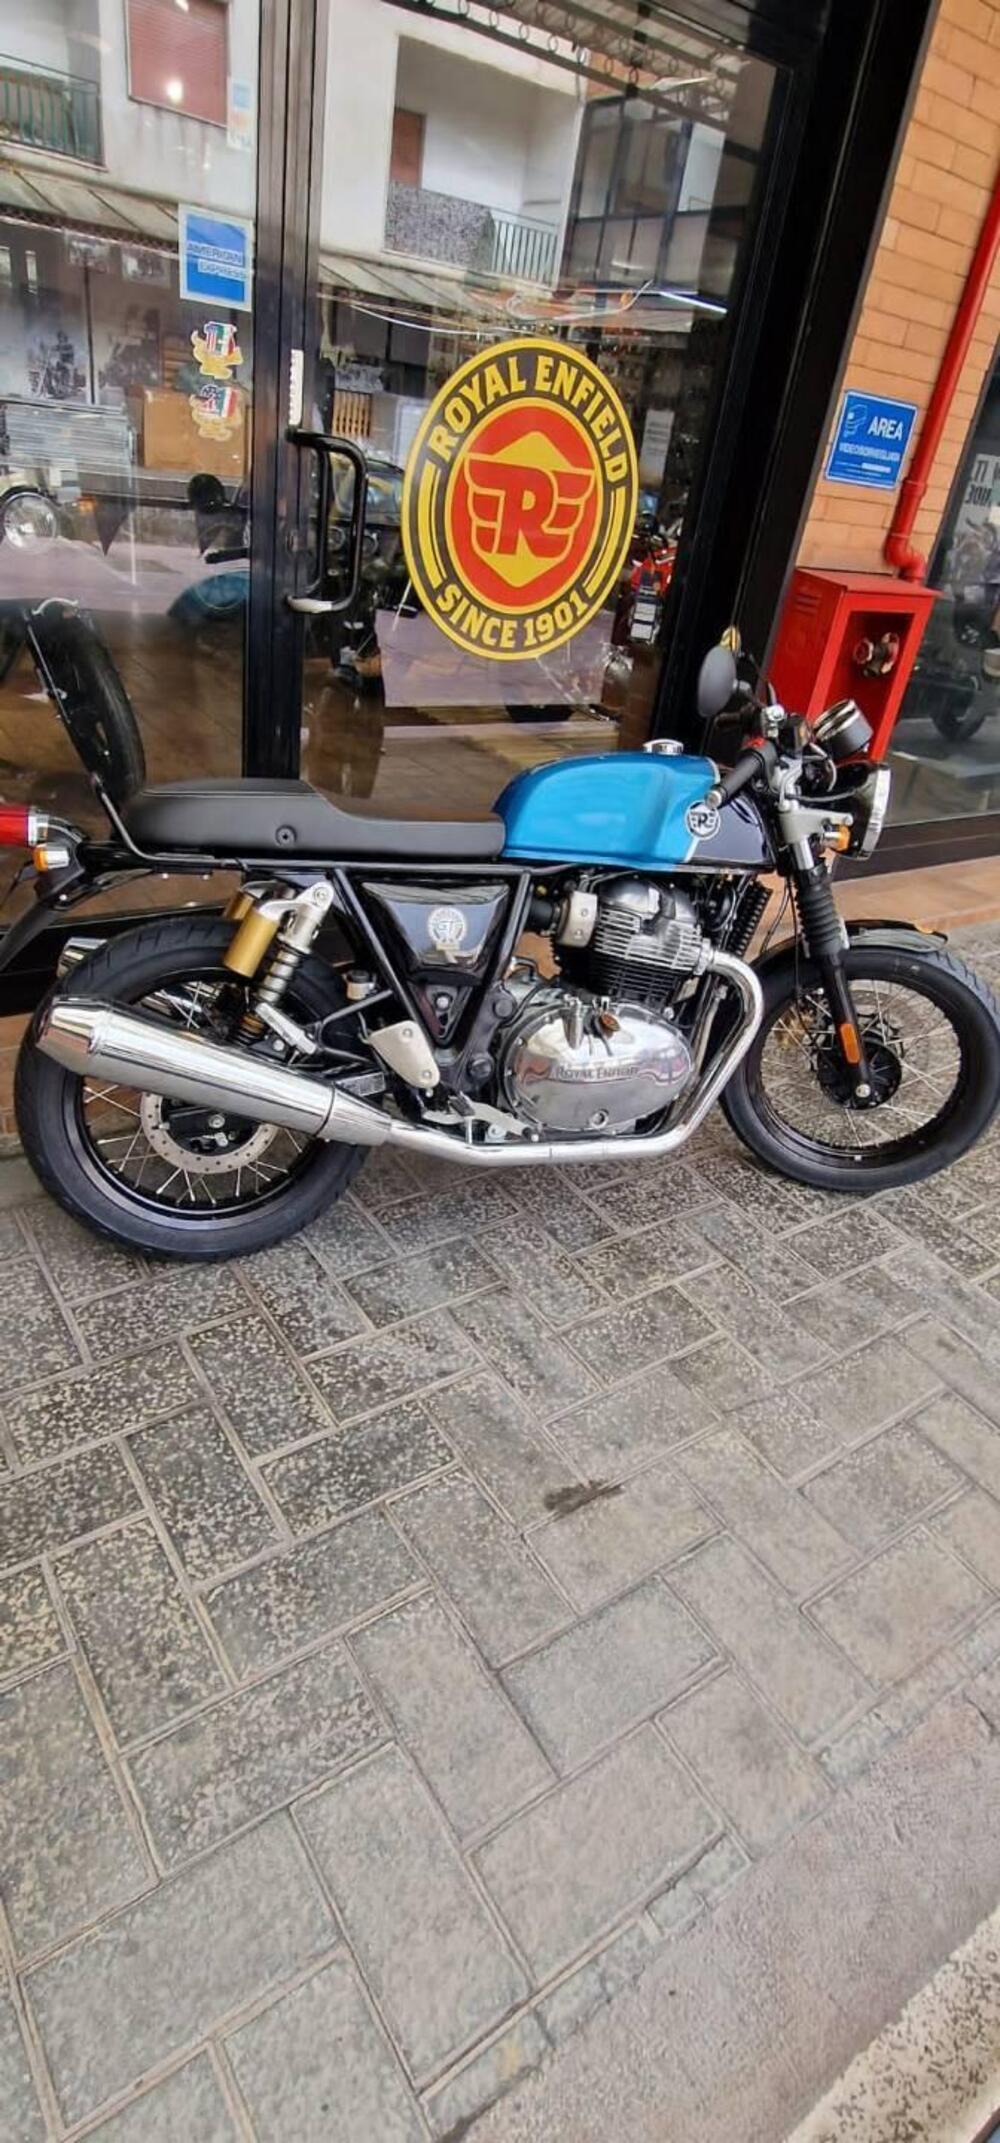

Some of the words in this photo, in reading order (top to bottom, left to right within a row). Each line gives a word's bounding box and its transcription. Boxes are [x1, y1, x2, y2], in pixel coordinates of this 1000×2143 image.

[428, 356, 526, 463] ROYAL
[534, 355, 628, 482] ENFIELD
[867, 416, 904, 441] AREA
[436, 584, 518, 648] SINCE
[523, 590, 588, 646] 1901
